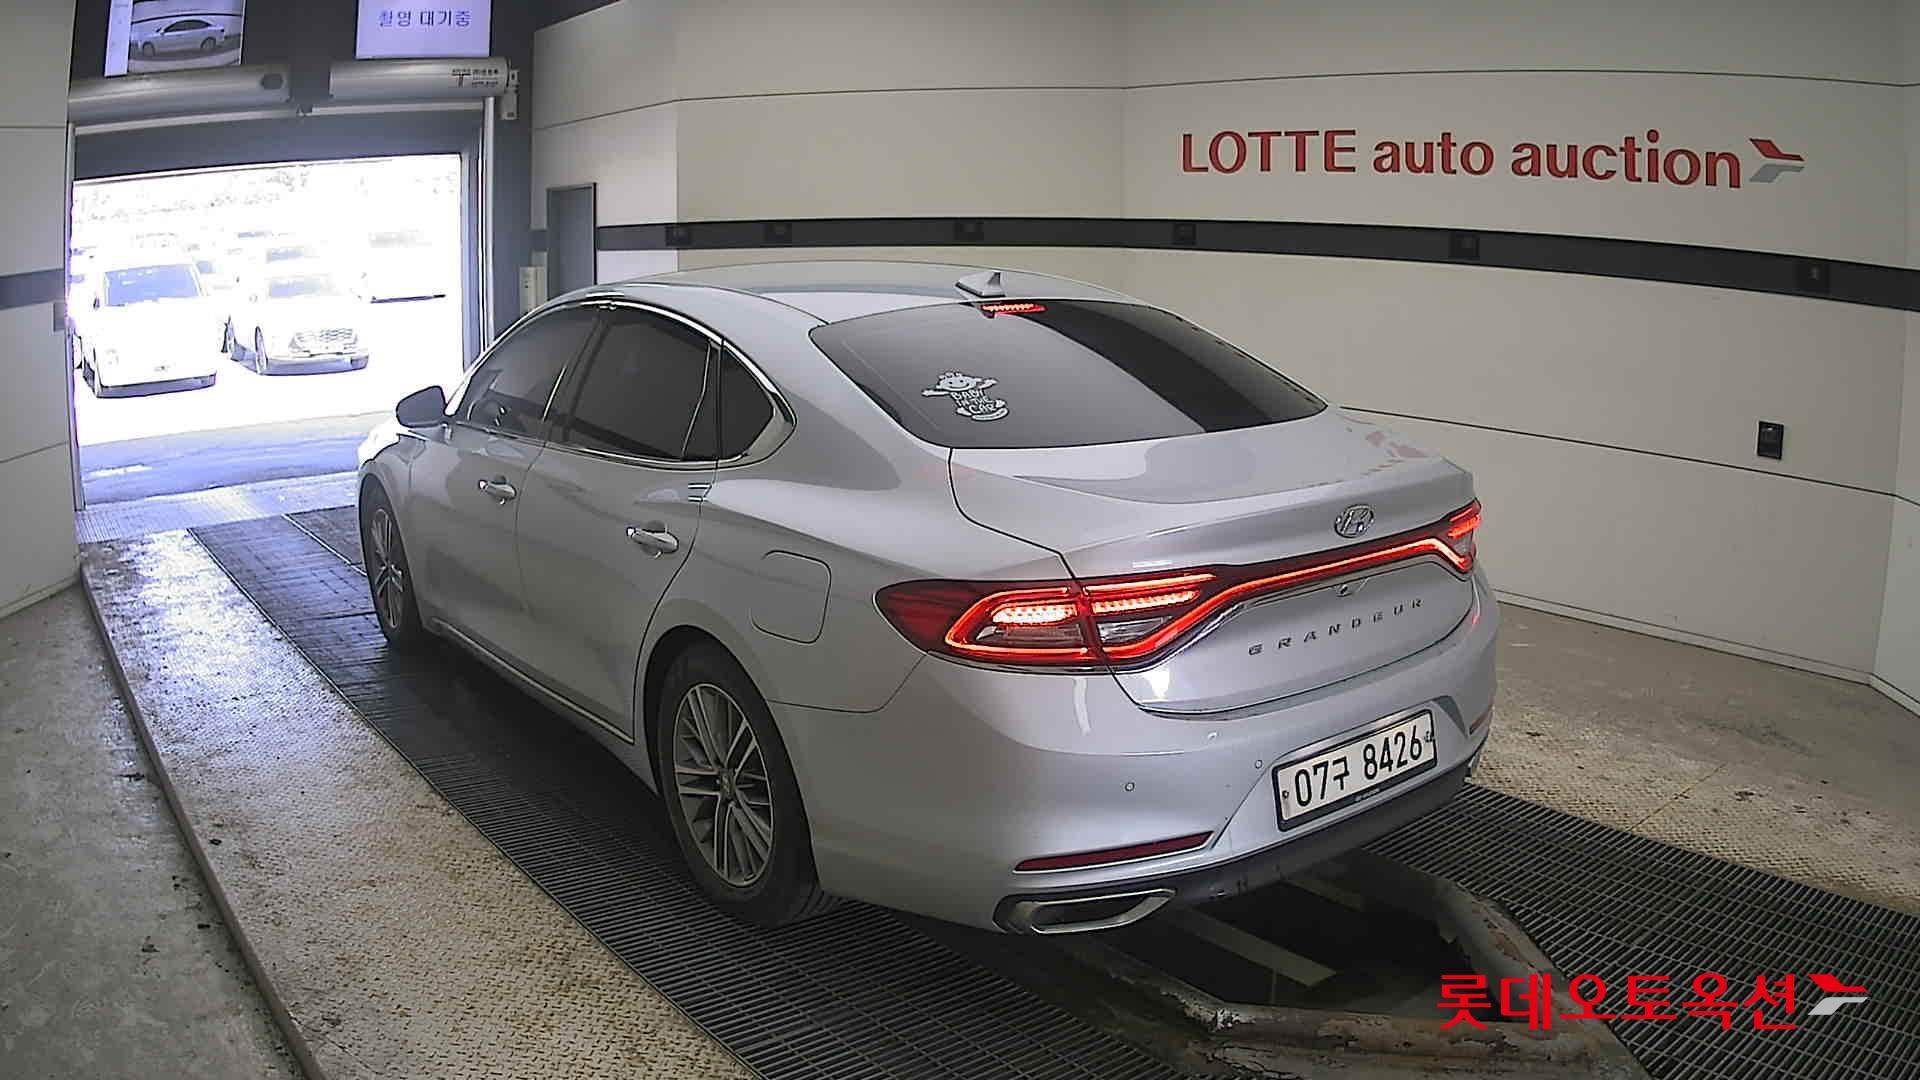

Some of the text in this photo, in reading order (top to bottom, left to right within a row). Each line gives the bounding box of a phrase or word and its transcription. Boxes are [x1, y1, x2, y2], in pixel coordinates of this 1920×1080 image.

[420, 10, 471, 27] 대기중
[1182, 129, 1741, 188] LOTTE auto auction
[969, 403, 997, 414] CAR
[1249, 599, 1424, 656] GRANDEUR
[1294, 725, 1422, 807] 07구 8426
